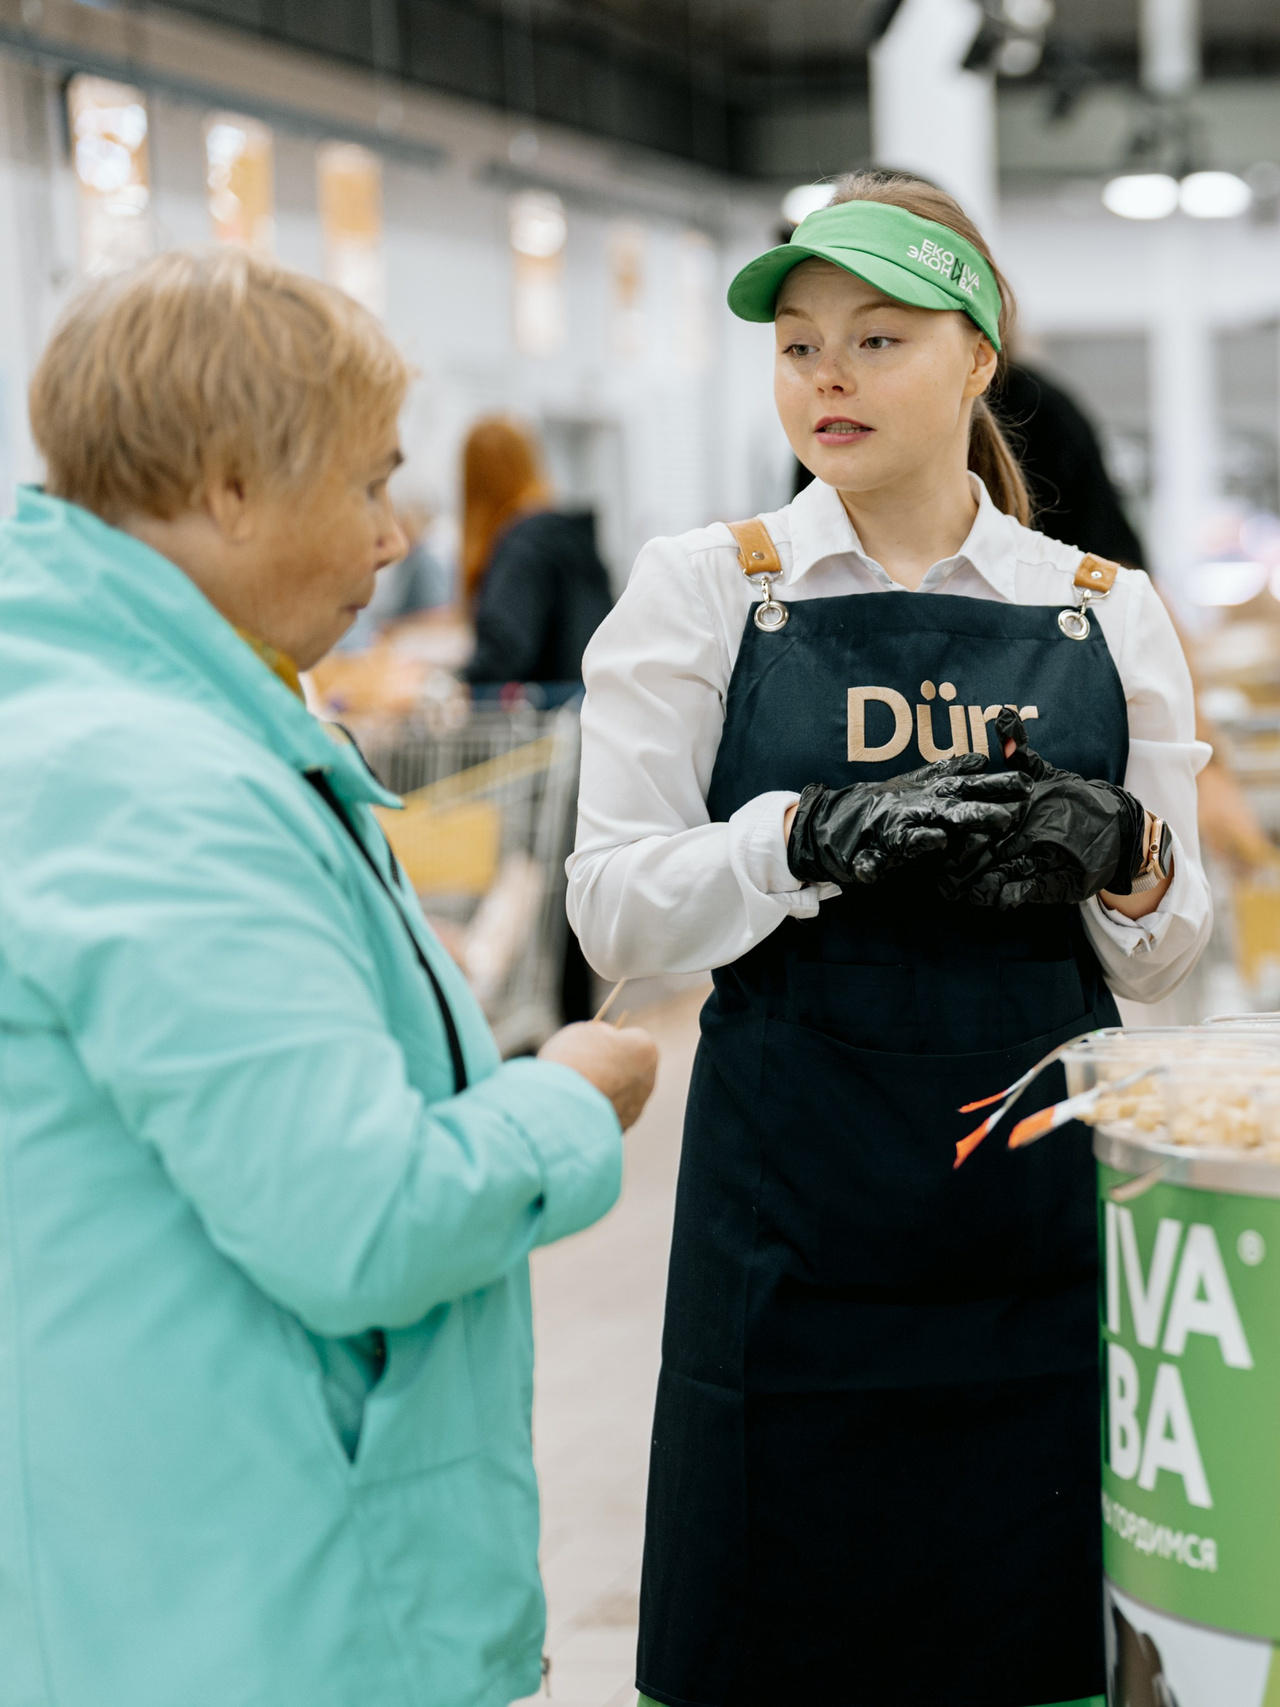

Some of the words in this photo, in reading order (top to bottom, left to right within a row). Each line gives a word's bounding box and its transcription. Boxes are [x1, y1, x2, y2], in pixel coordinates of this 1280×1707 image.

[906, 245, 974, 298] ЭКОНИВА
[921, 239, 979, 290] EKONIVA
[1102, 1201, 1255, 1370] IVA
[1104, 1341, 1214, 1509] ВА
